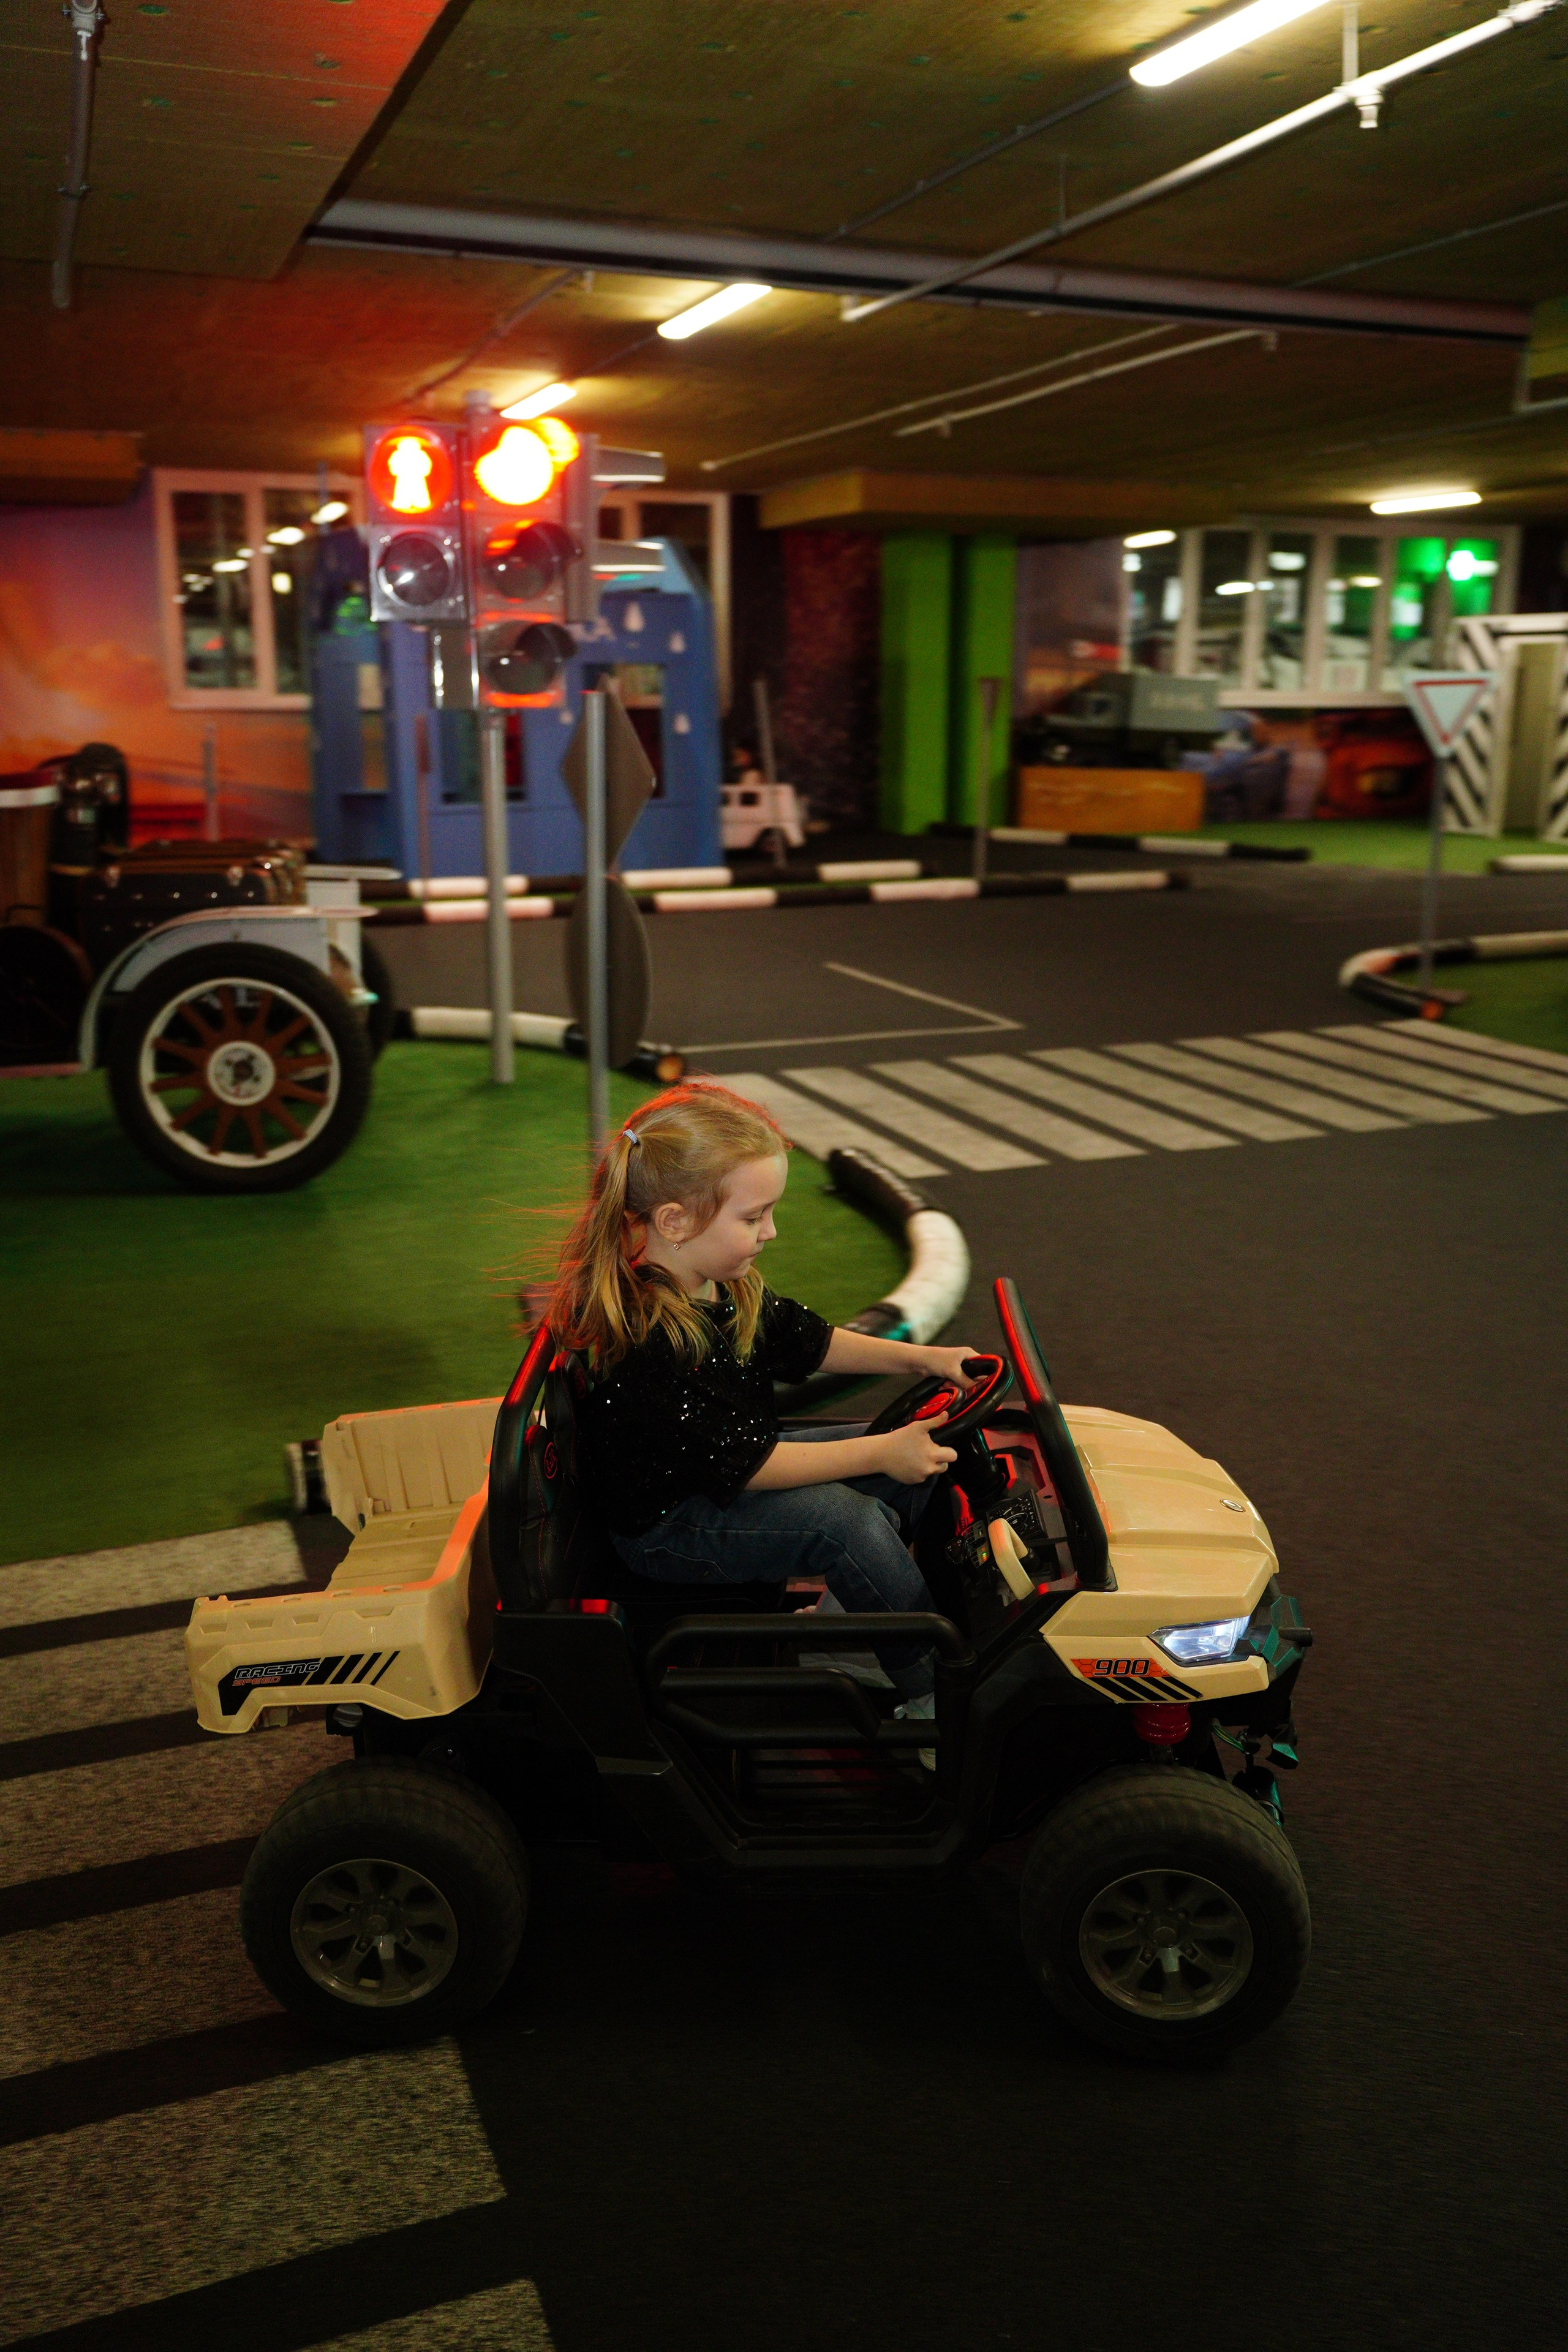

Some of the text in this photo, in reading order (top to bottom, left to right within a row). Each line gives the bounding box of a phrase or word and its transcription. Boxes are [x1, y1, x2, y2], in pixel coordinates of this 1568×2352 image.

[235, 1662, 321, 1679] RACING
[1093, 1659, 1150, 1676] 900
[232, 1676, 282, 1687] SPEED
